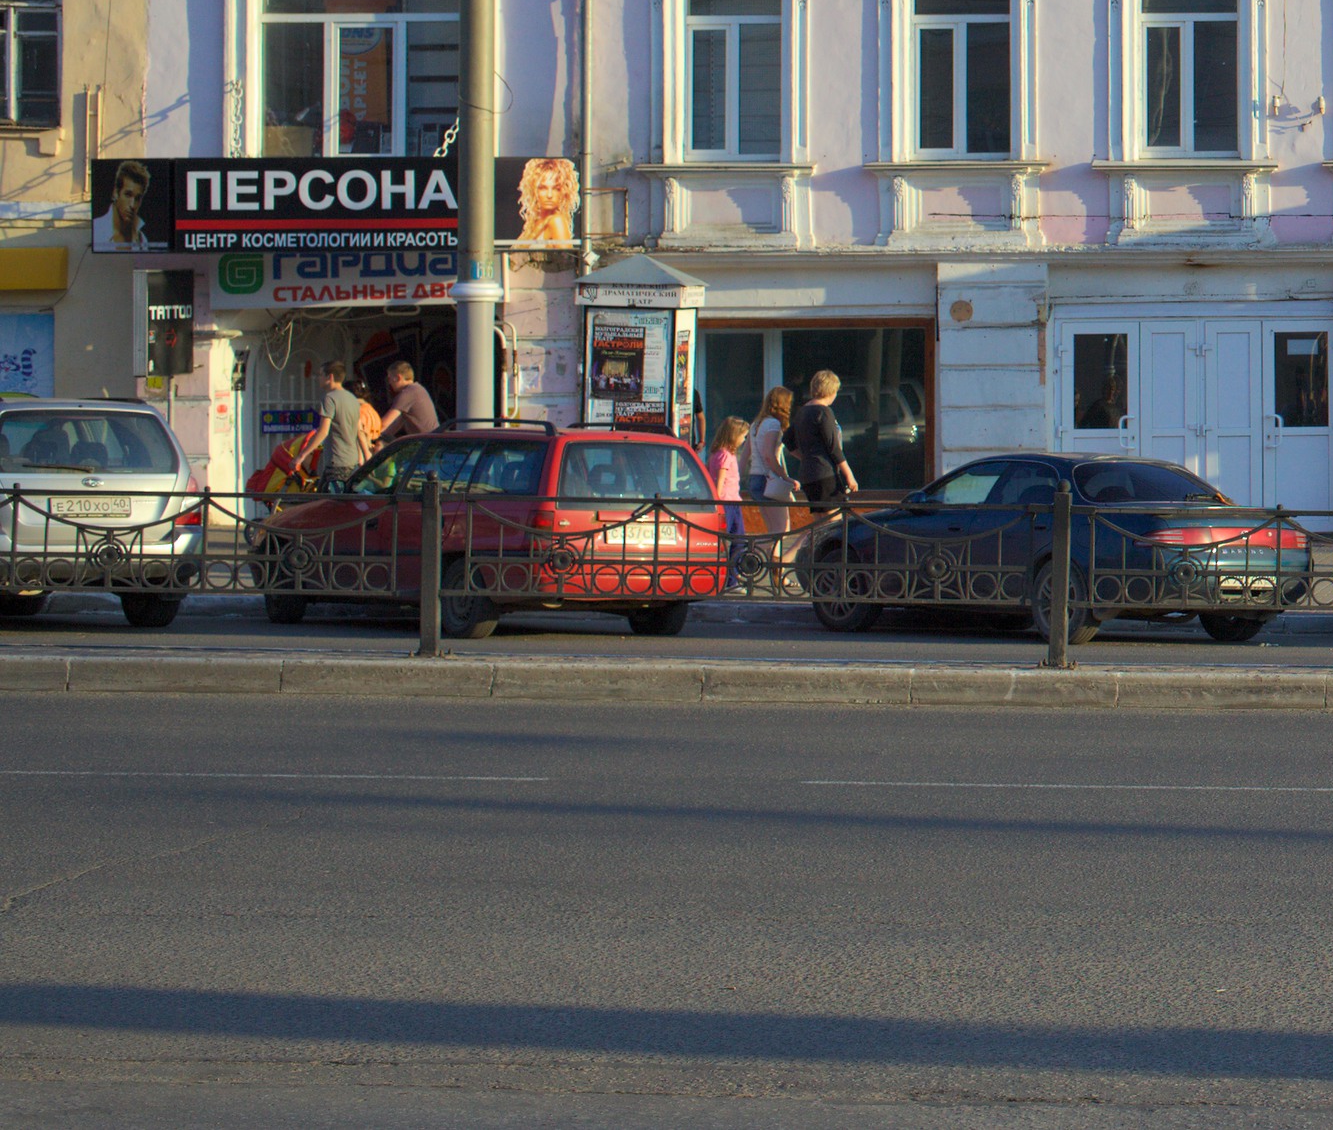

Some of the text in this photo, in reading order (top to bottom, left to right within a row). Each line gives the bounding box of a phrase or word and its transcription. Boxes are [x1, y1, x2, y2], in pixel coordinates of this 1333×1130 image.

[186, 169, 458, 211] ПЕРСОНА
[184, 233, 237, 250] ЦЕНТР
[242, 232, 371, 249] КОСМЕТОЛОГИИ
[373, 232, 385, 248] И
[272, 283, 407, 302] СТАЛЬНЫЕ
[601, 289, 678, 298] ДРАМАТИЧЕСКИЙ
[148, 304, 193, 321] TATTOO
[593, 339, 644, 349] ГАСТРОЛИ
